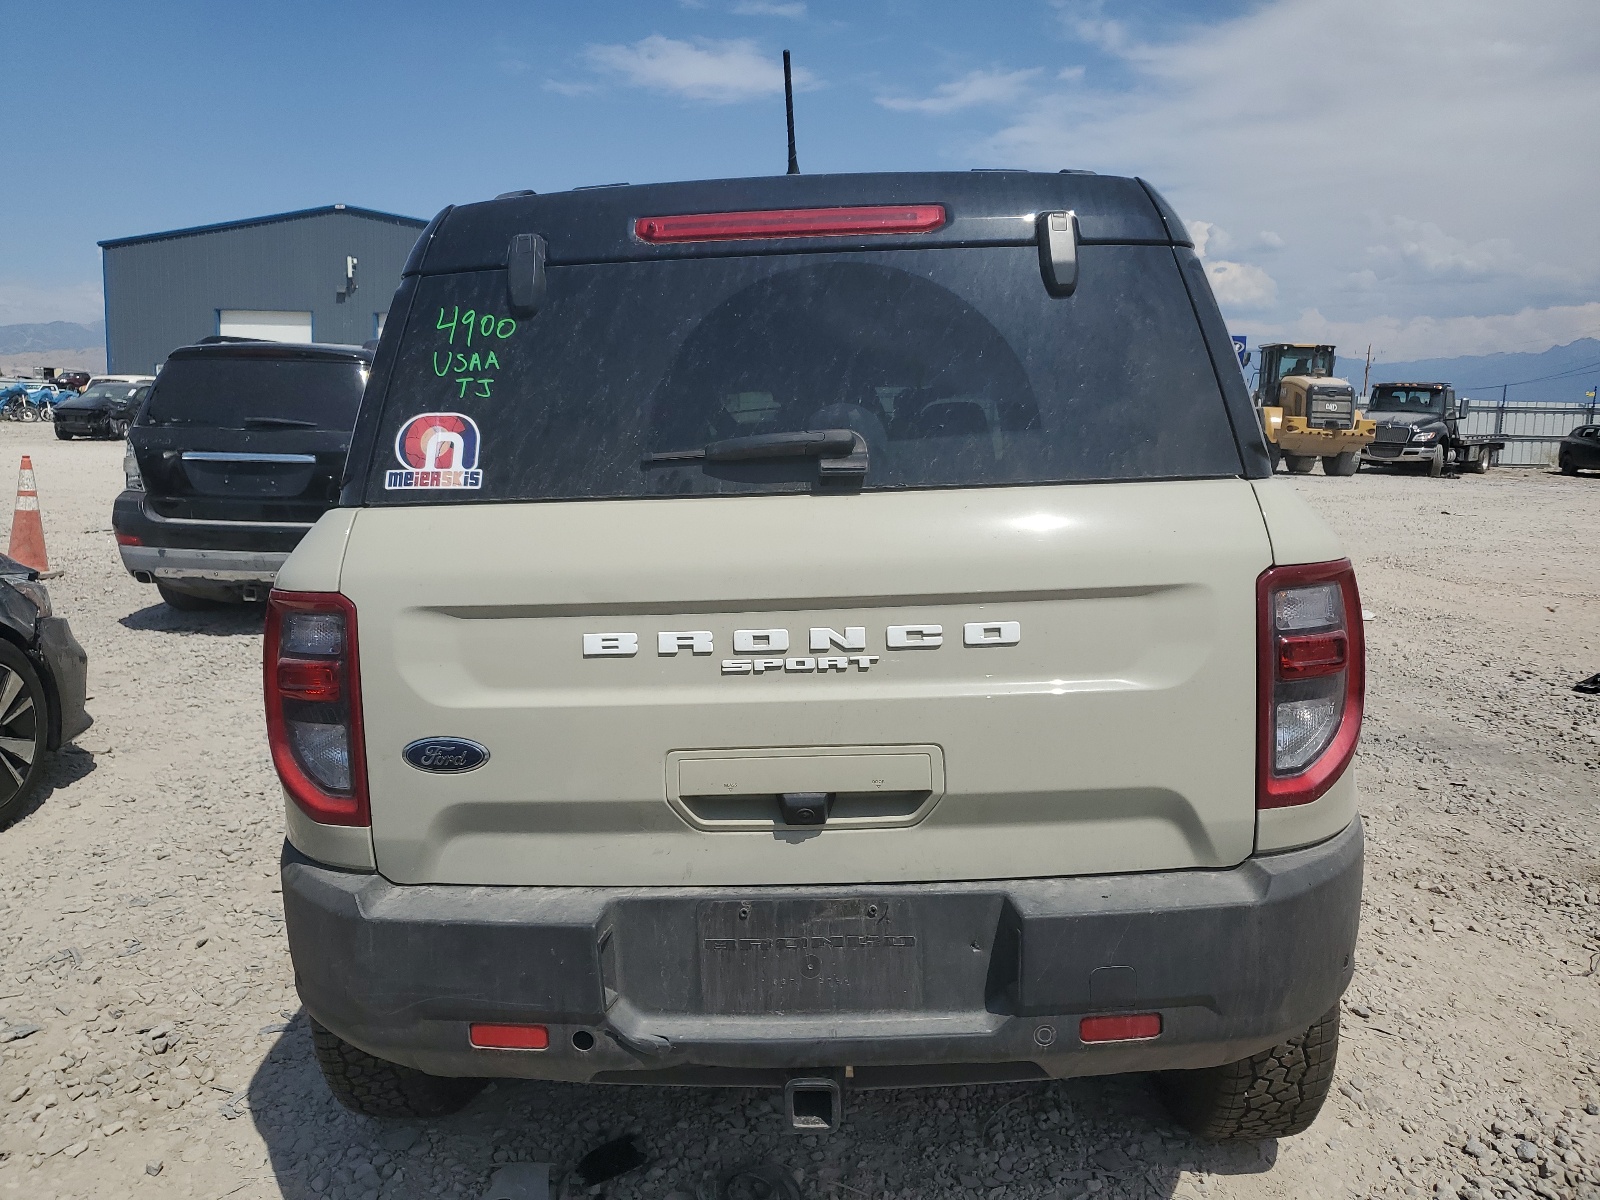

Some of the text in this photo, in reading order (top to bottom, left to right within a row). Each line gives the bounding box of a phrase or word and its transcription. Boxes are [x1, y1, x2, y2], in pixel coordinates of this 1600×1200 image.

[437, 306, 516, 346] 4900
[433, 351, 500, 376] USAA
[456, 377, 494, 398] TJ
[1325, 403, 1338, 412] CAT
[583, 621, 1021, 658] BRONCO
[721, 655, 880, 676] SPORT
[420, 745, 468, 766] Ford
